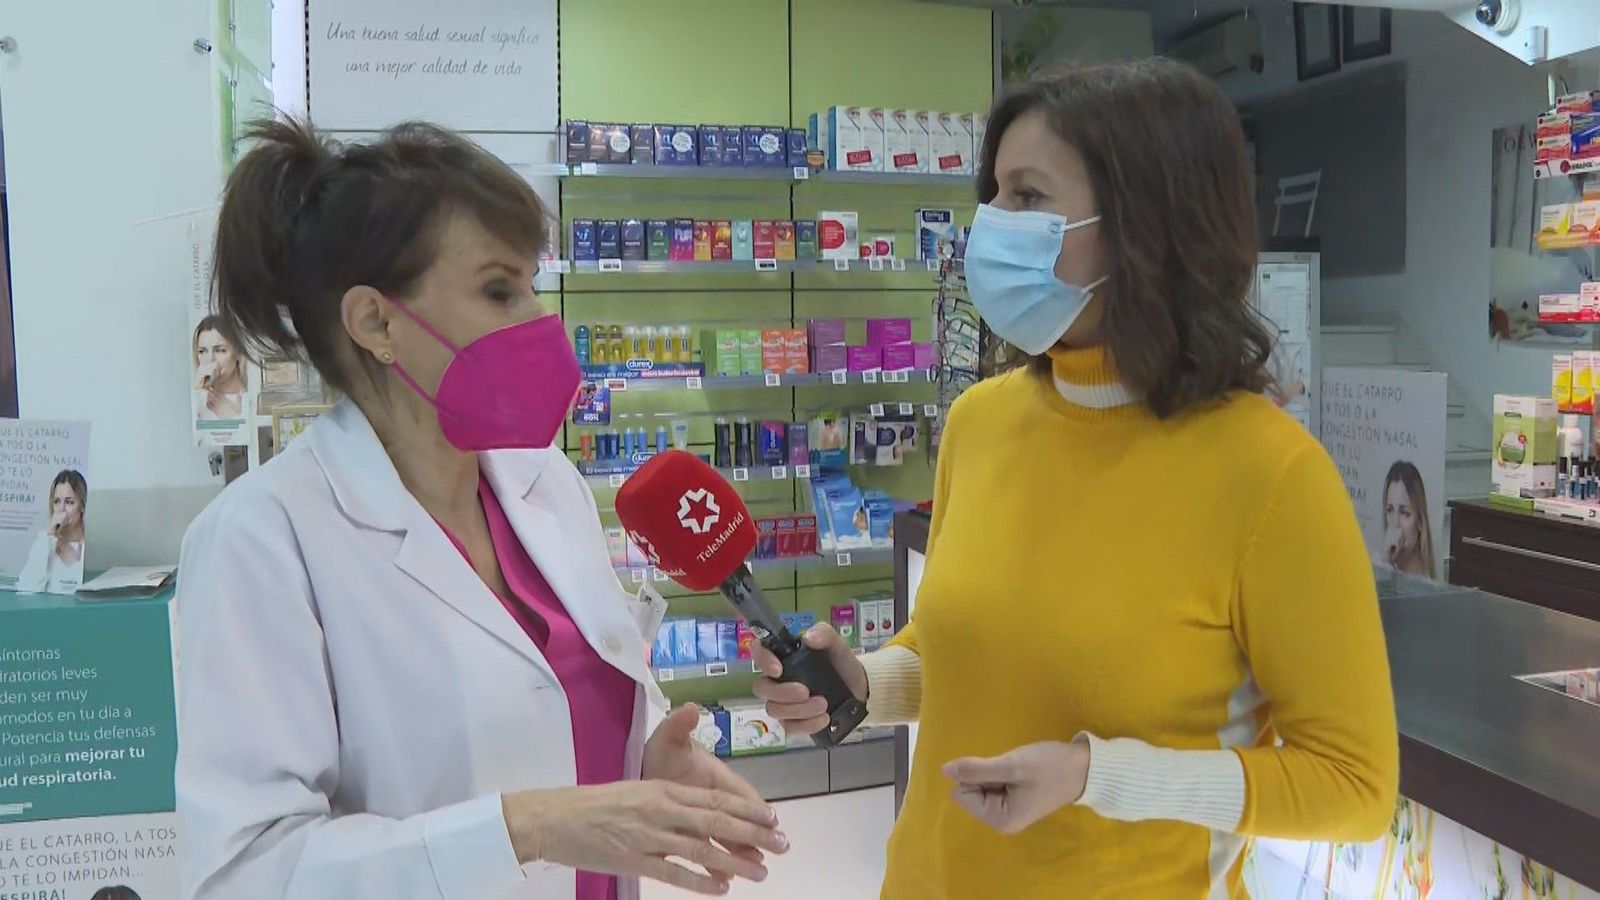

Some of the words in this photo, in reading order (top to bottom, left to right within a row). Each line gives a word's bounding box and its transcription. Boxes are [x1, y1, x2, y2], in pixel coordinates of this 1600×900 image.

[326, 21, 356, 41] Una
[362, 26, 399, 41] buena
[404, 23, 440, 41] salud
[446, 26, 487, 43] sexual
[491, 26, 540, 53] significa
[345, 61, 370, 73] una
[375, 58, 417, 80] mejor
[422, 56, 468, 75] calidad
[472, 59, 489, 75] de
[494, 60, 522, 75] vida
[28, 428, 70, 440] CATARRO
[696, 511, 744, 563] TeleMadrid
[62, 667, 98, 680] leves
[31, 691, 51, 703] ser
[56, 688, 88, 704] muy
[0, 710, 53, 724] modos
[57, 711, 76, 723] en
[80, 708, 95, 721] tu
[98, 706, 120, 720] día
[124, 707, 132, 718] a
[2, 730, 65, 746] Potencia
[68, 730, 90, 742] tus
[94, 725, 156, 741] defensas
[30, 753, 61, 769] para
[65, 747, 125, 764] mejorar
[130, 746, 145, 758] tu
[22, 768, 117, 788] respiratoria.
[20, 837, 38, 850] EL
[44, 831, 119, 849] CATARRO,
[125, 830, 144, 843] LA
[148, 827, 177, 841] TOS
[0, 857, 19, 870] LA
[25, 847, 128, 868] CONGESTIÓN
[135, 845, 176, 859] NASA
[11, 873, 30, 887] TE
[36, 871, 57, 885] LO
[63, 866, 144, 883] IMPIDAN...
